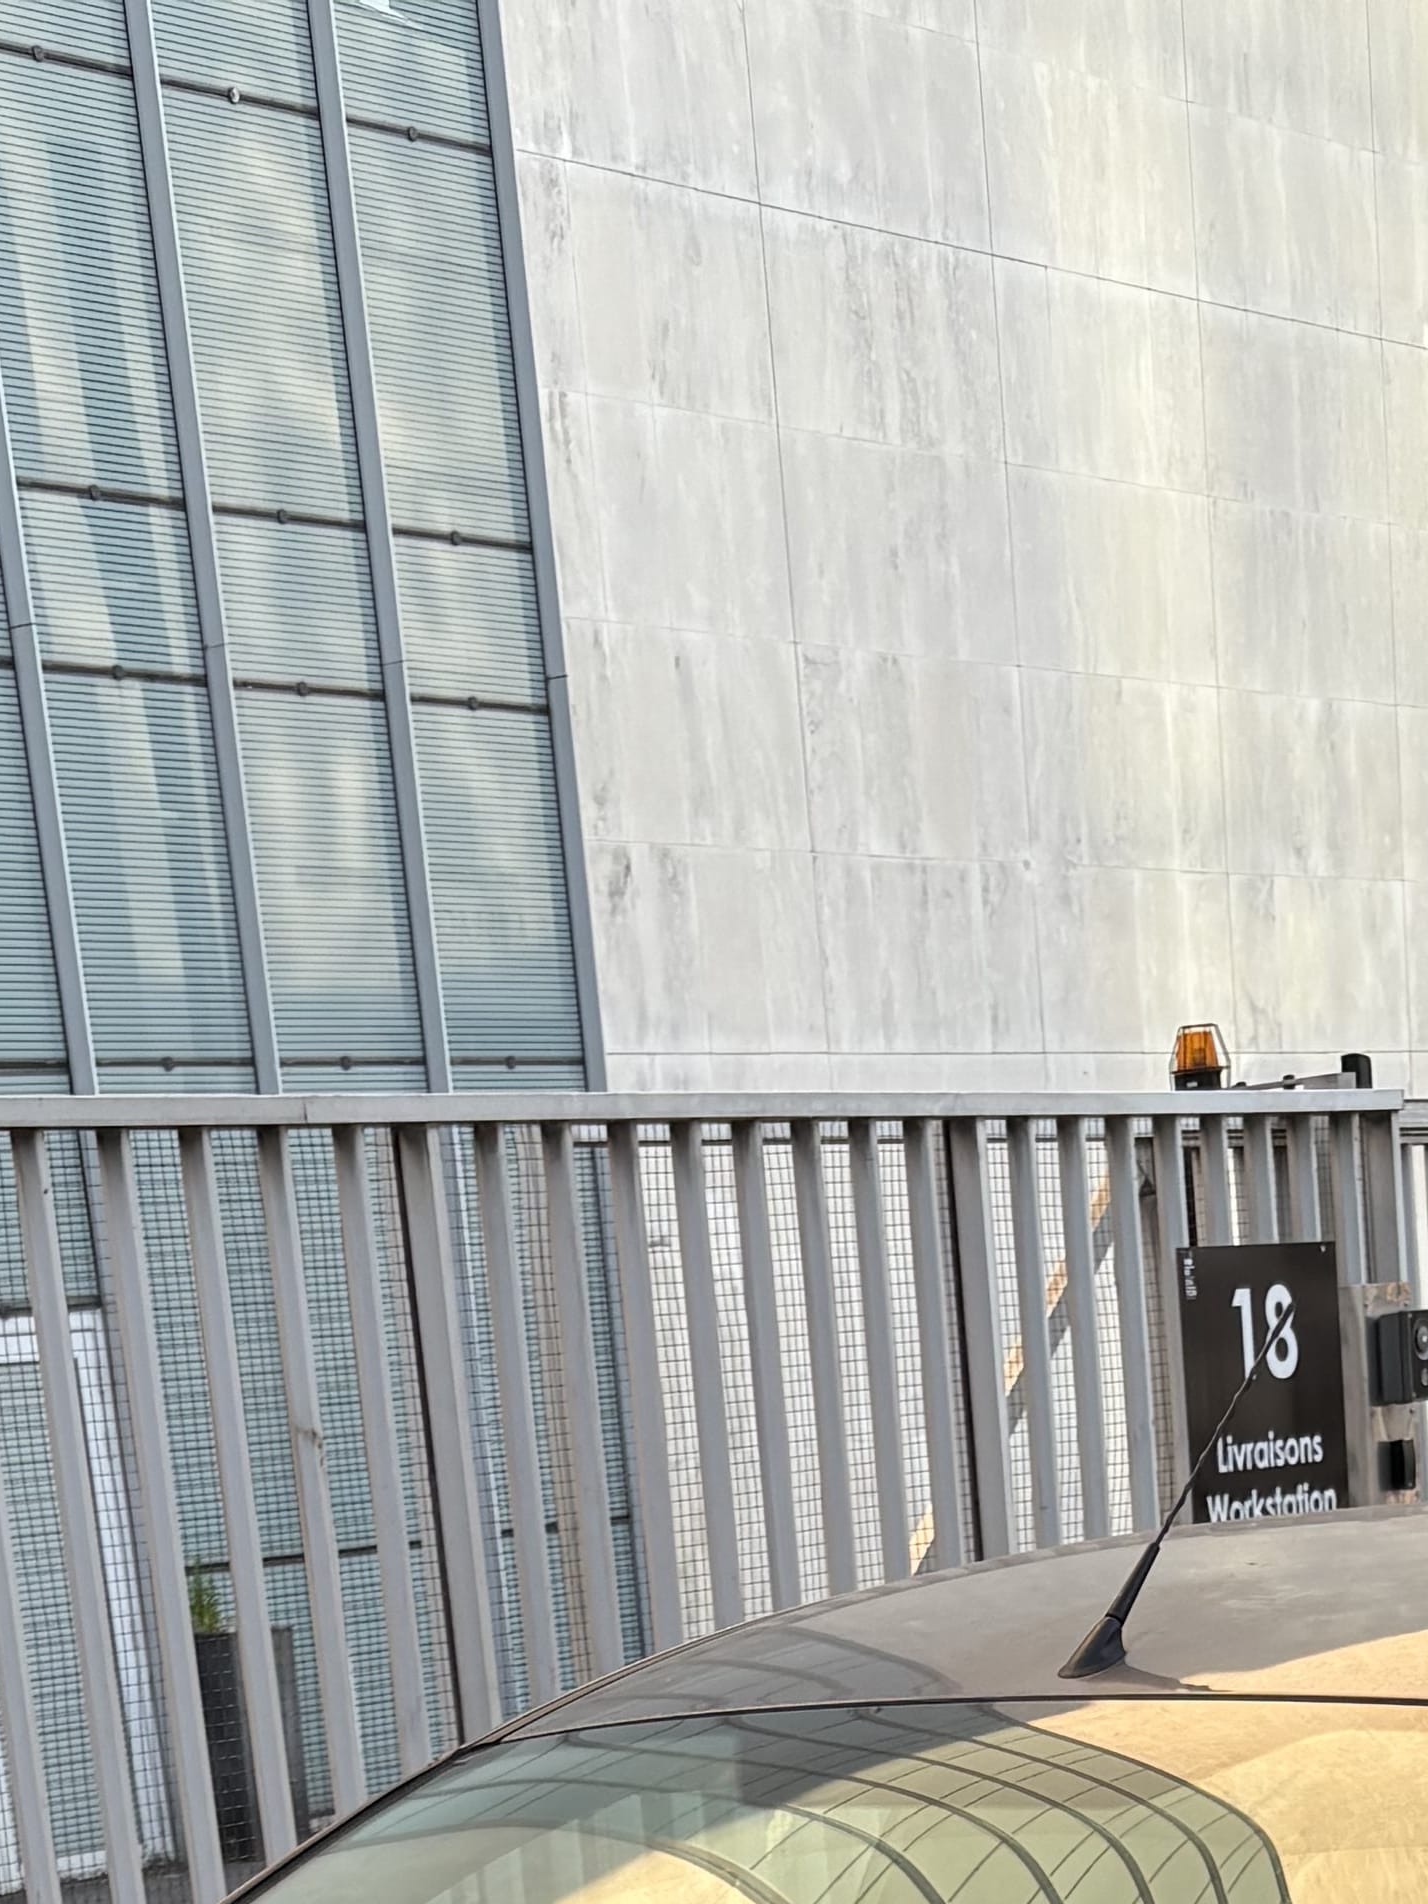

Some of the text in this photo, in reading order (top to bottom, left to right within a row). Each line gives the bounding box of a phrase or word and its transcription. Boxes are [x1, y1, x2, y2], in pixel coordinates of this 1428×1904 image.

[1231, 1284, 1299, 1379] 18
[1217, 1430, 1324, 1473] Livraisons
[1206, 1482, 1337, 1523] Workstation
